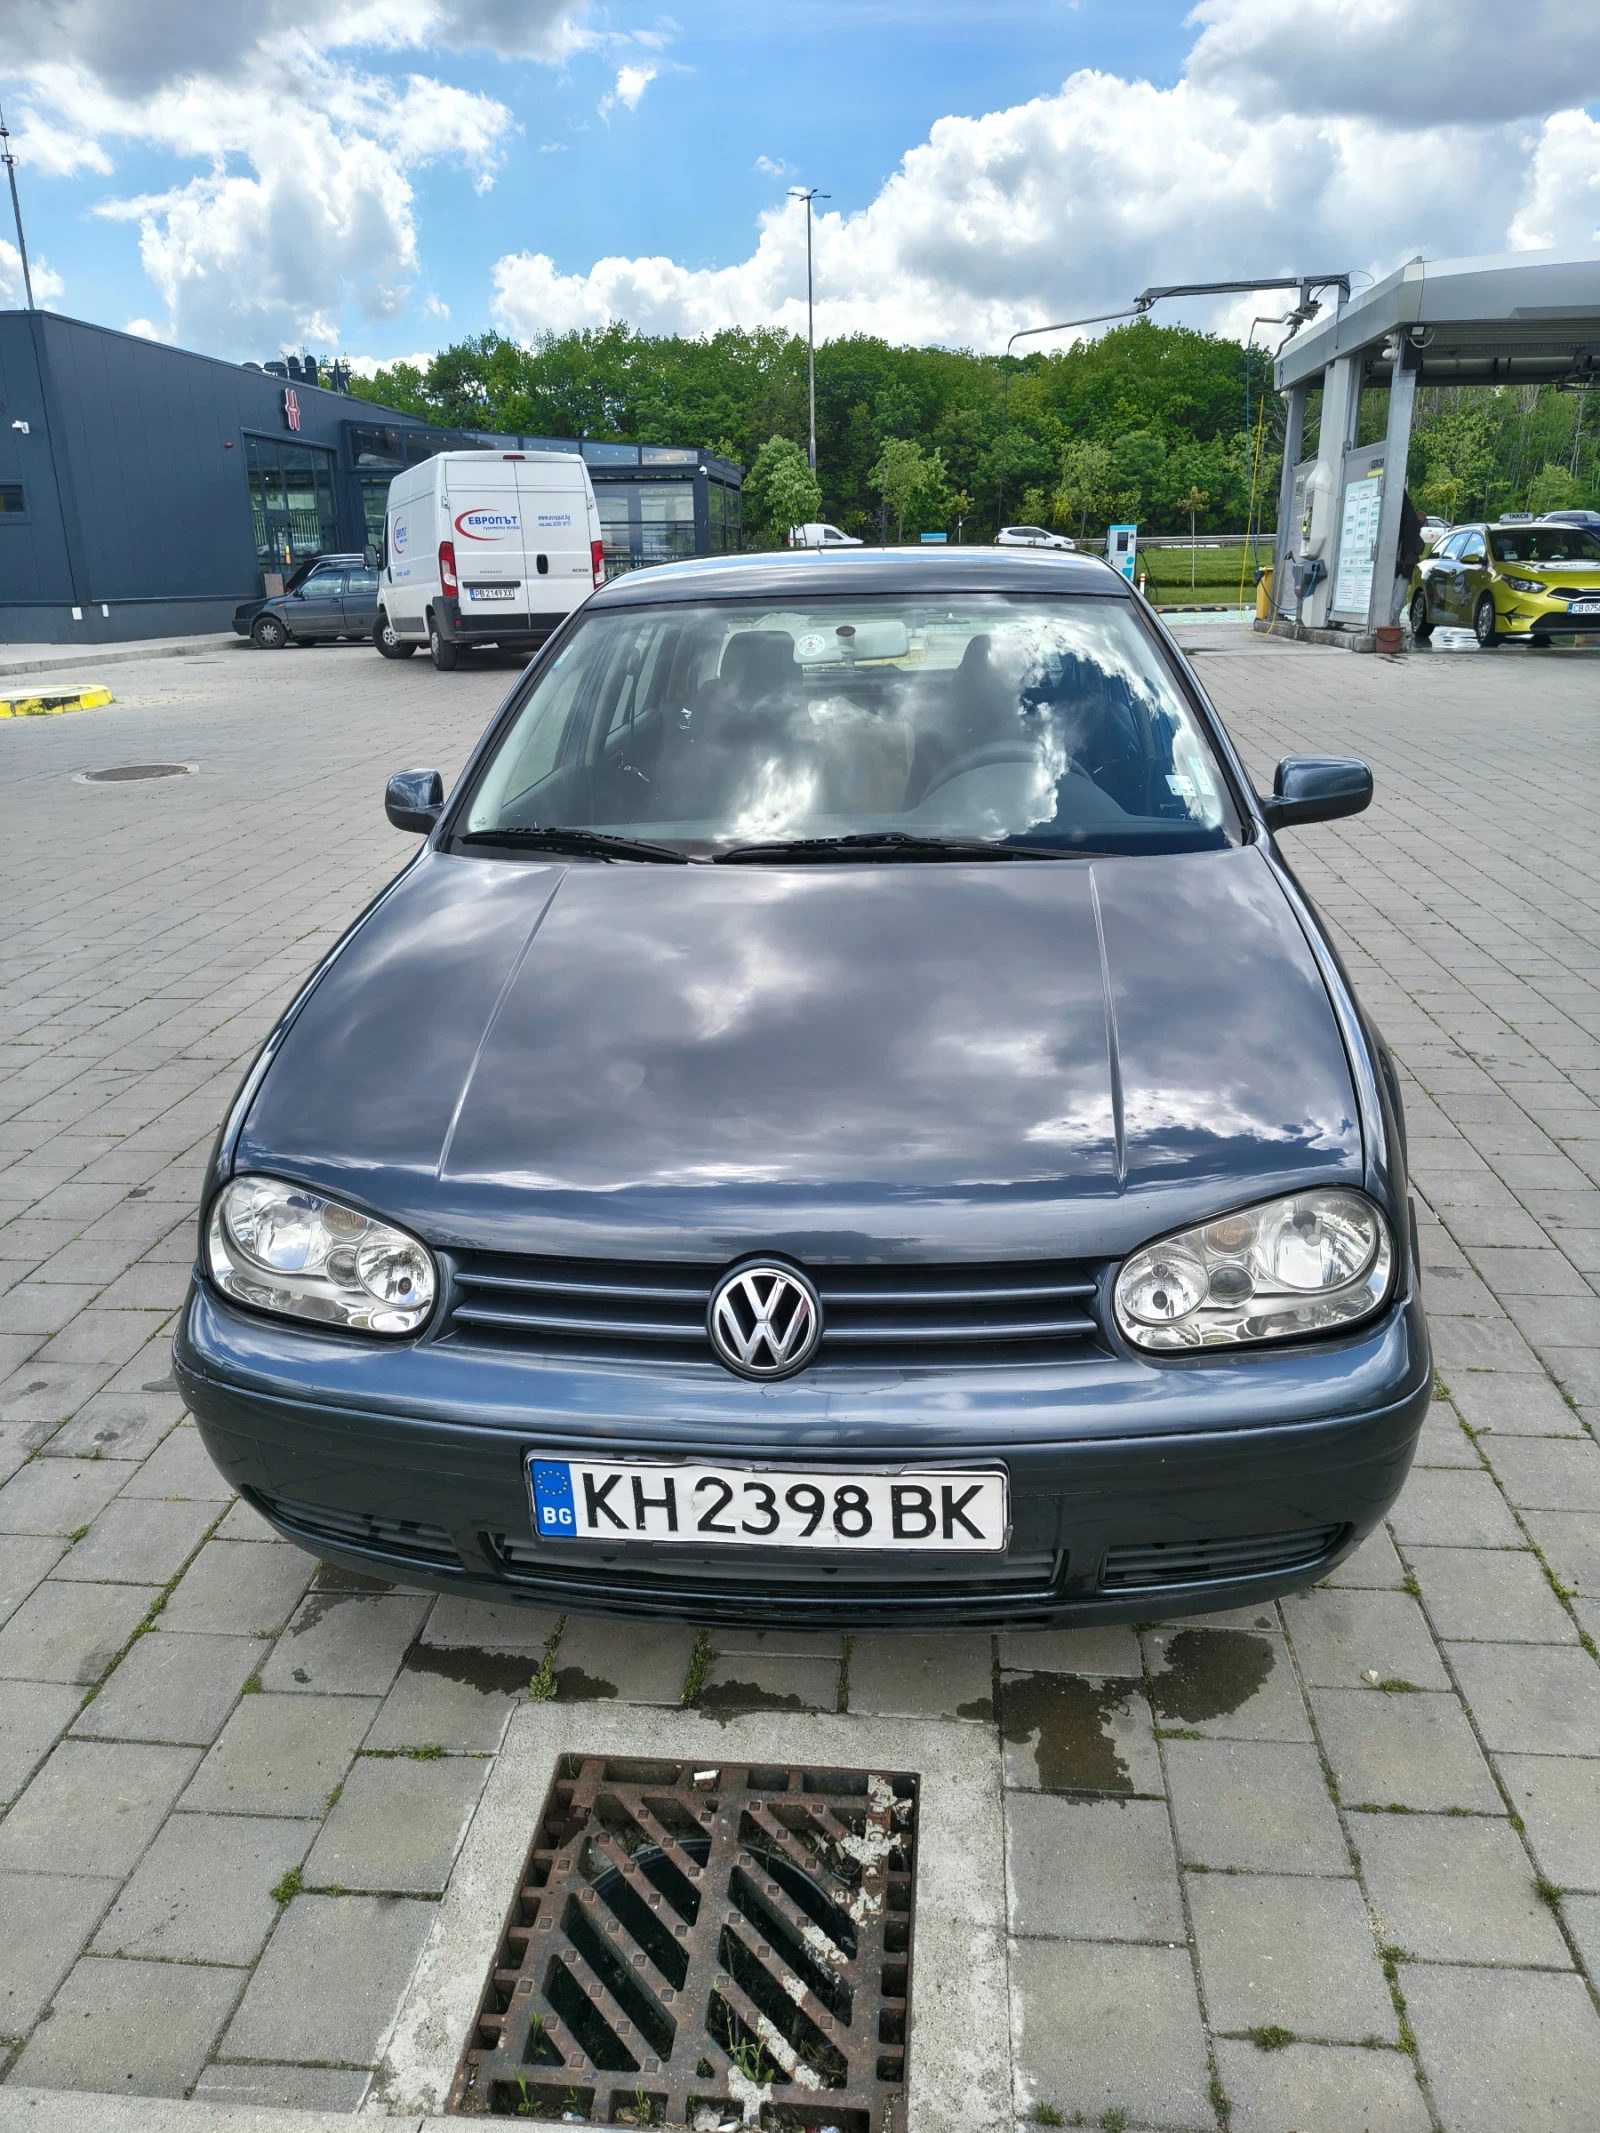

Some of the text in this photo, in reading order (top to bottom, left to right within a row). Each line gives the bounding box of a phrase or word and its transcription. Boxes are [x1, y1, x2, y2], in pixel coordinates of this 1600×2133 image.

[468, 516, 517, 525] ЕВРОПЪТ
[1585, 604, 1600, 612] 075
[582, 1472, 986, 1540] KH 2398 BK
[543, 1507, 572, 1525] BG
